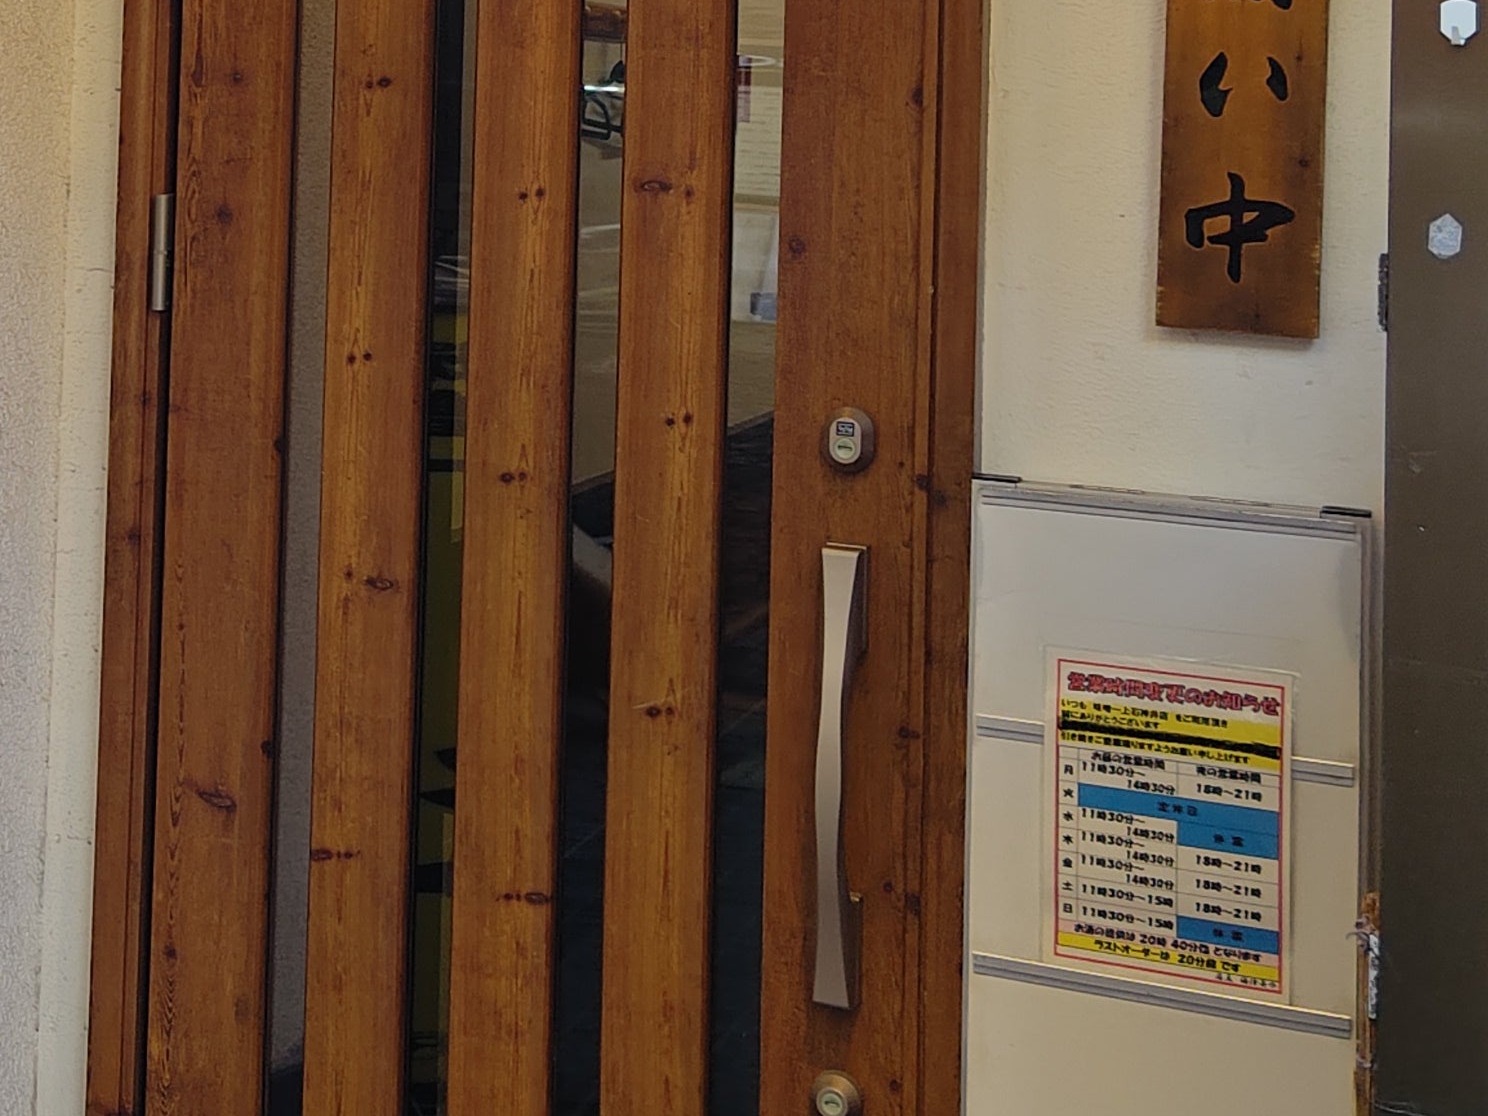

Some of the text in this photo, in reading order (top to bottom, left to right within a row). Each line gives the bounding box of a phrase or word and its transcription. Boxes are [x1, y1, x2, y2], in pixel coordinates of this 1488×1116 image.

[1064, 764, 1073, 775] 月
[1062, 881, 1074, 891] 土
[1063, 903, 1073, 914] 日
